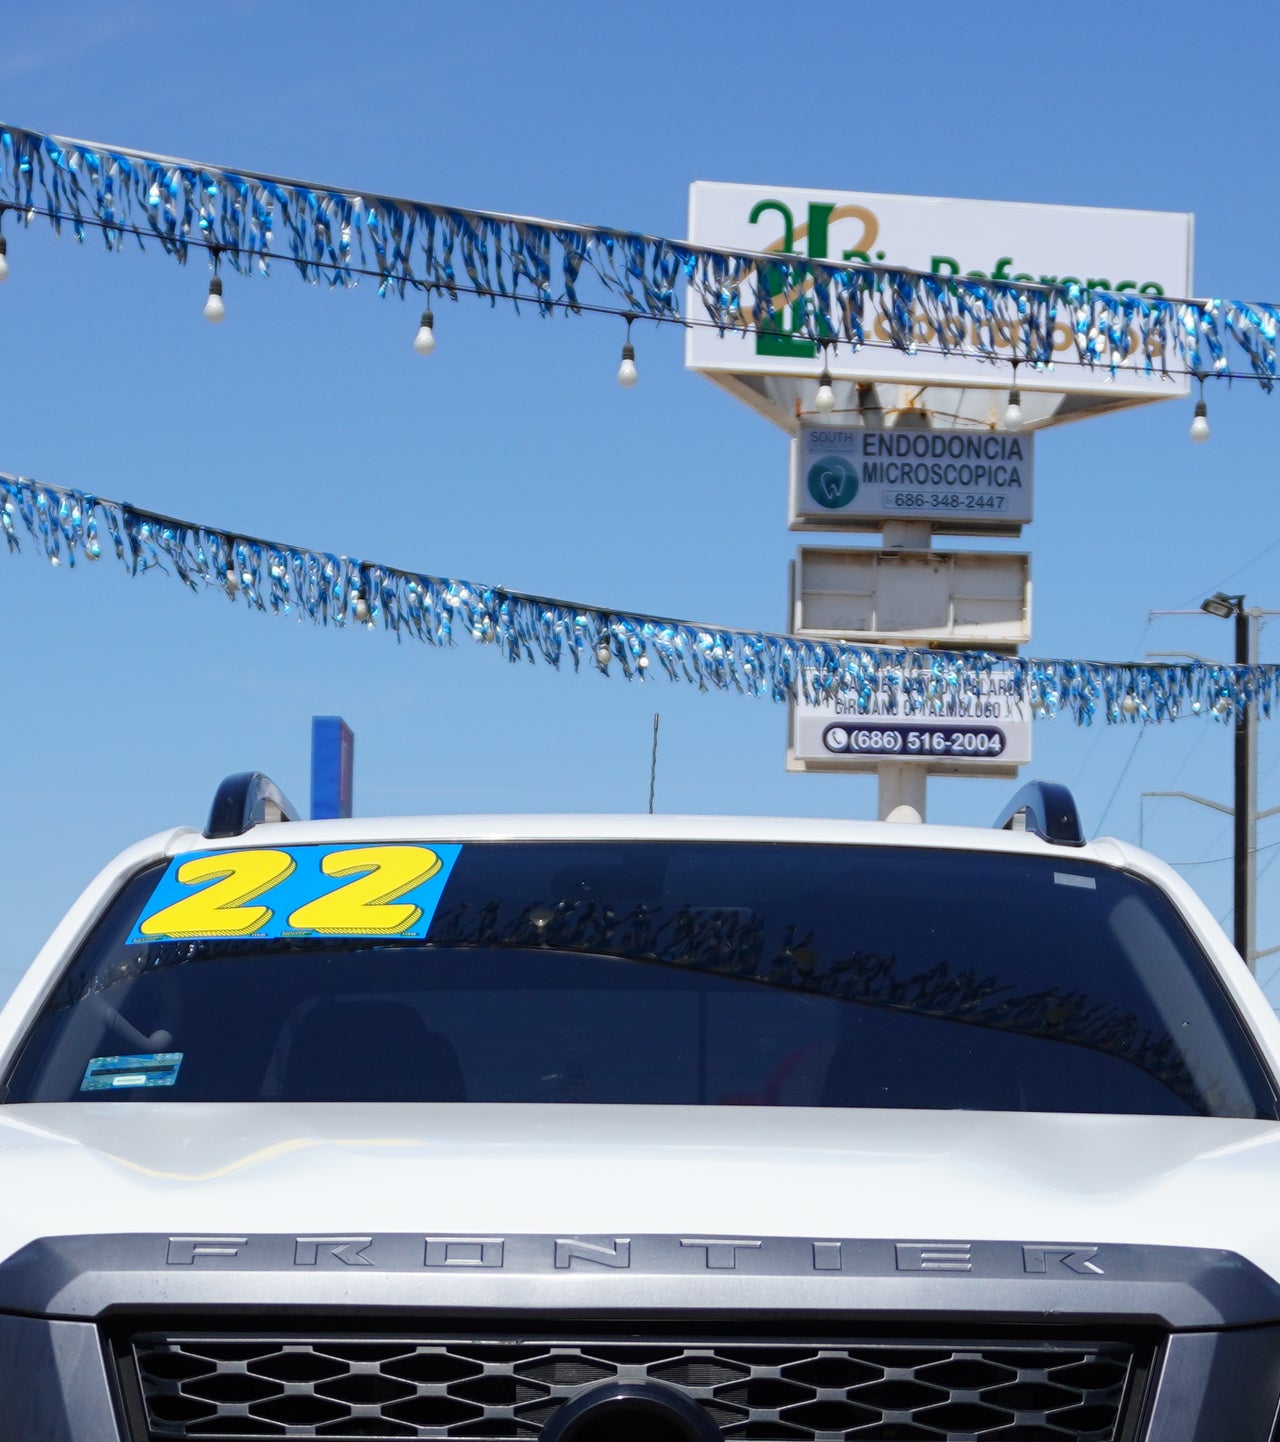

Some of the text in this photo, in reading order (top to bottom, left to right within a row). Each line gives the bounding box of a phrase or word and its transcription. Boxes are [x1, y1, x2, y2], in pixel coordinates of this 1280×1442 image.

[863, 433, 1023, 461] ENDODONCIA
[863, 462, 1022, 488] MICROSCOPICA
[895, 492, 1005, 509] 686-348-2447
[850, 729, 1002, 751] (686) 516-2004
[140, 845, 442, 938] 22
[166, 1235, 1105, 1275] FRONTIER
